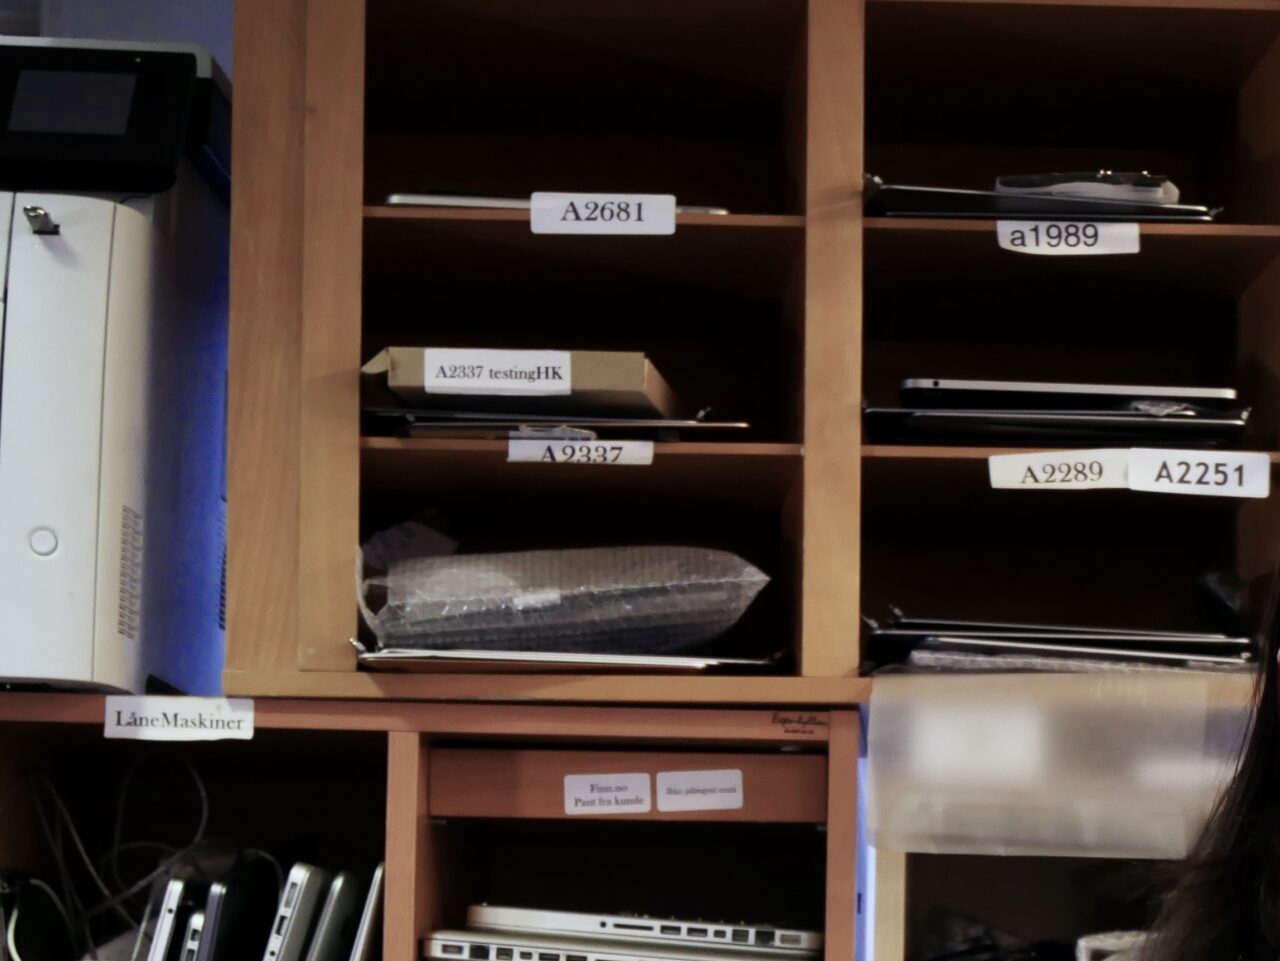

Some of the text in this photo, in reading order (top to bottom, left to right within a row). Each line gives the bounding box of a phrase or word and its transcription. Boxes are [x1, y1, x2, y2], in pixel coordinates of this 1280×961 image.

[560, 200, 644, 222] A2681
[1010, 223, 1099, 248] a1989
[435, 365, 564, 383] A2337 testingHK
[541, 445, 624, 464] A2337
[1020, 460, 1104, 484] A2289
[1154, 461, 1245, 487] A2251
[115, 709, 245, 730] LåneMaskiner
